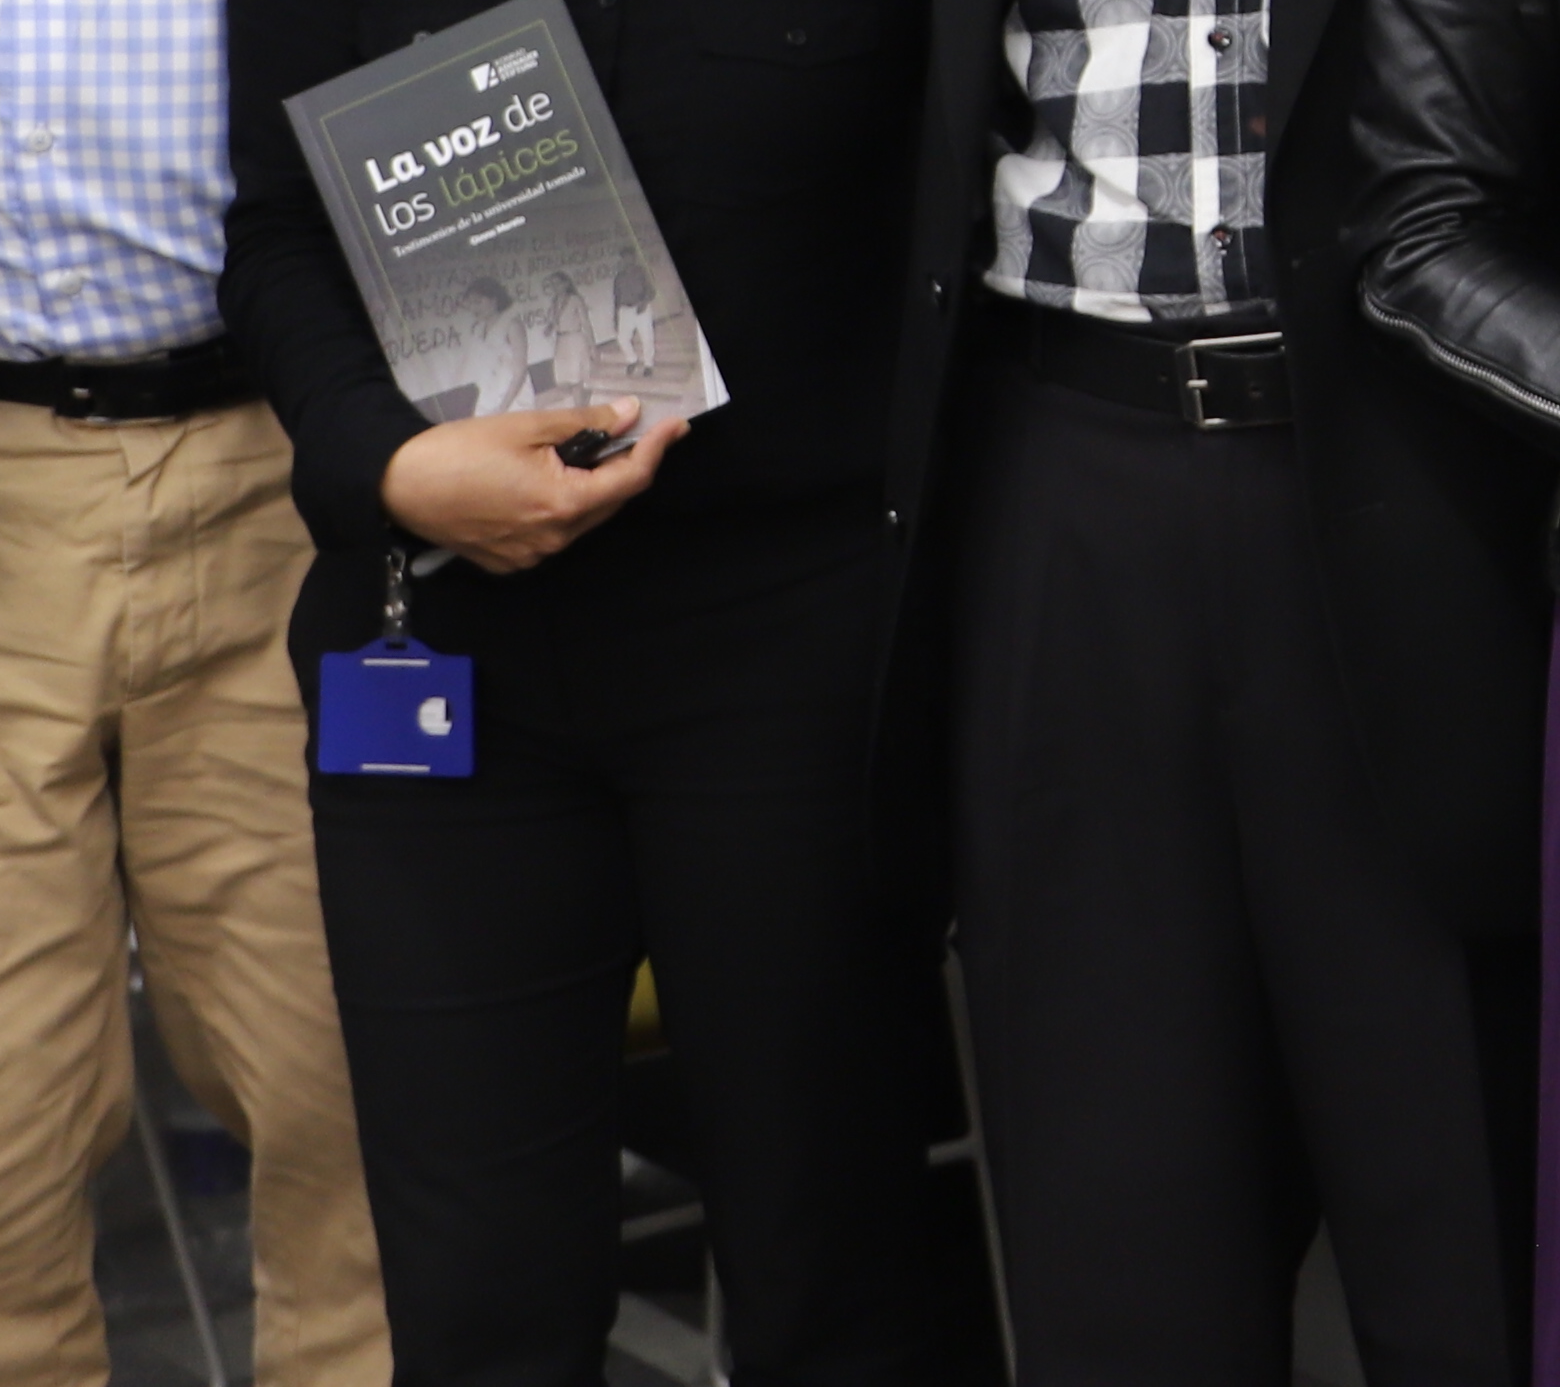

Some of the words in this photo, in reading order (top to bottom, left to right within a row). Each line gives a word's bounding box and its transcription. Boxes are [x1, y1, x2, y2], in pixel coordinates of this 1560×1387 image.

[366, 150, 425, 193] La
[424, 116, 501, 167] voz
[503, 92, 553, 132] de
[374, 192, 435, 236] los
[440, 129, 578, 207] lápices
